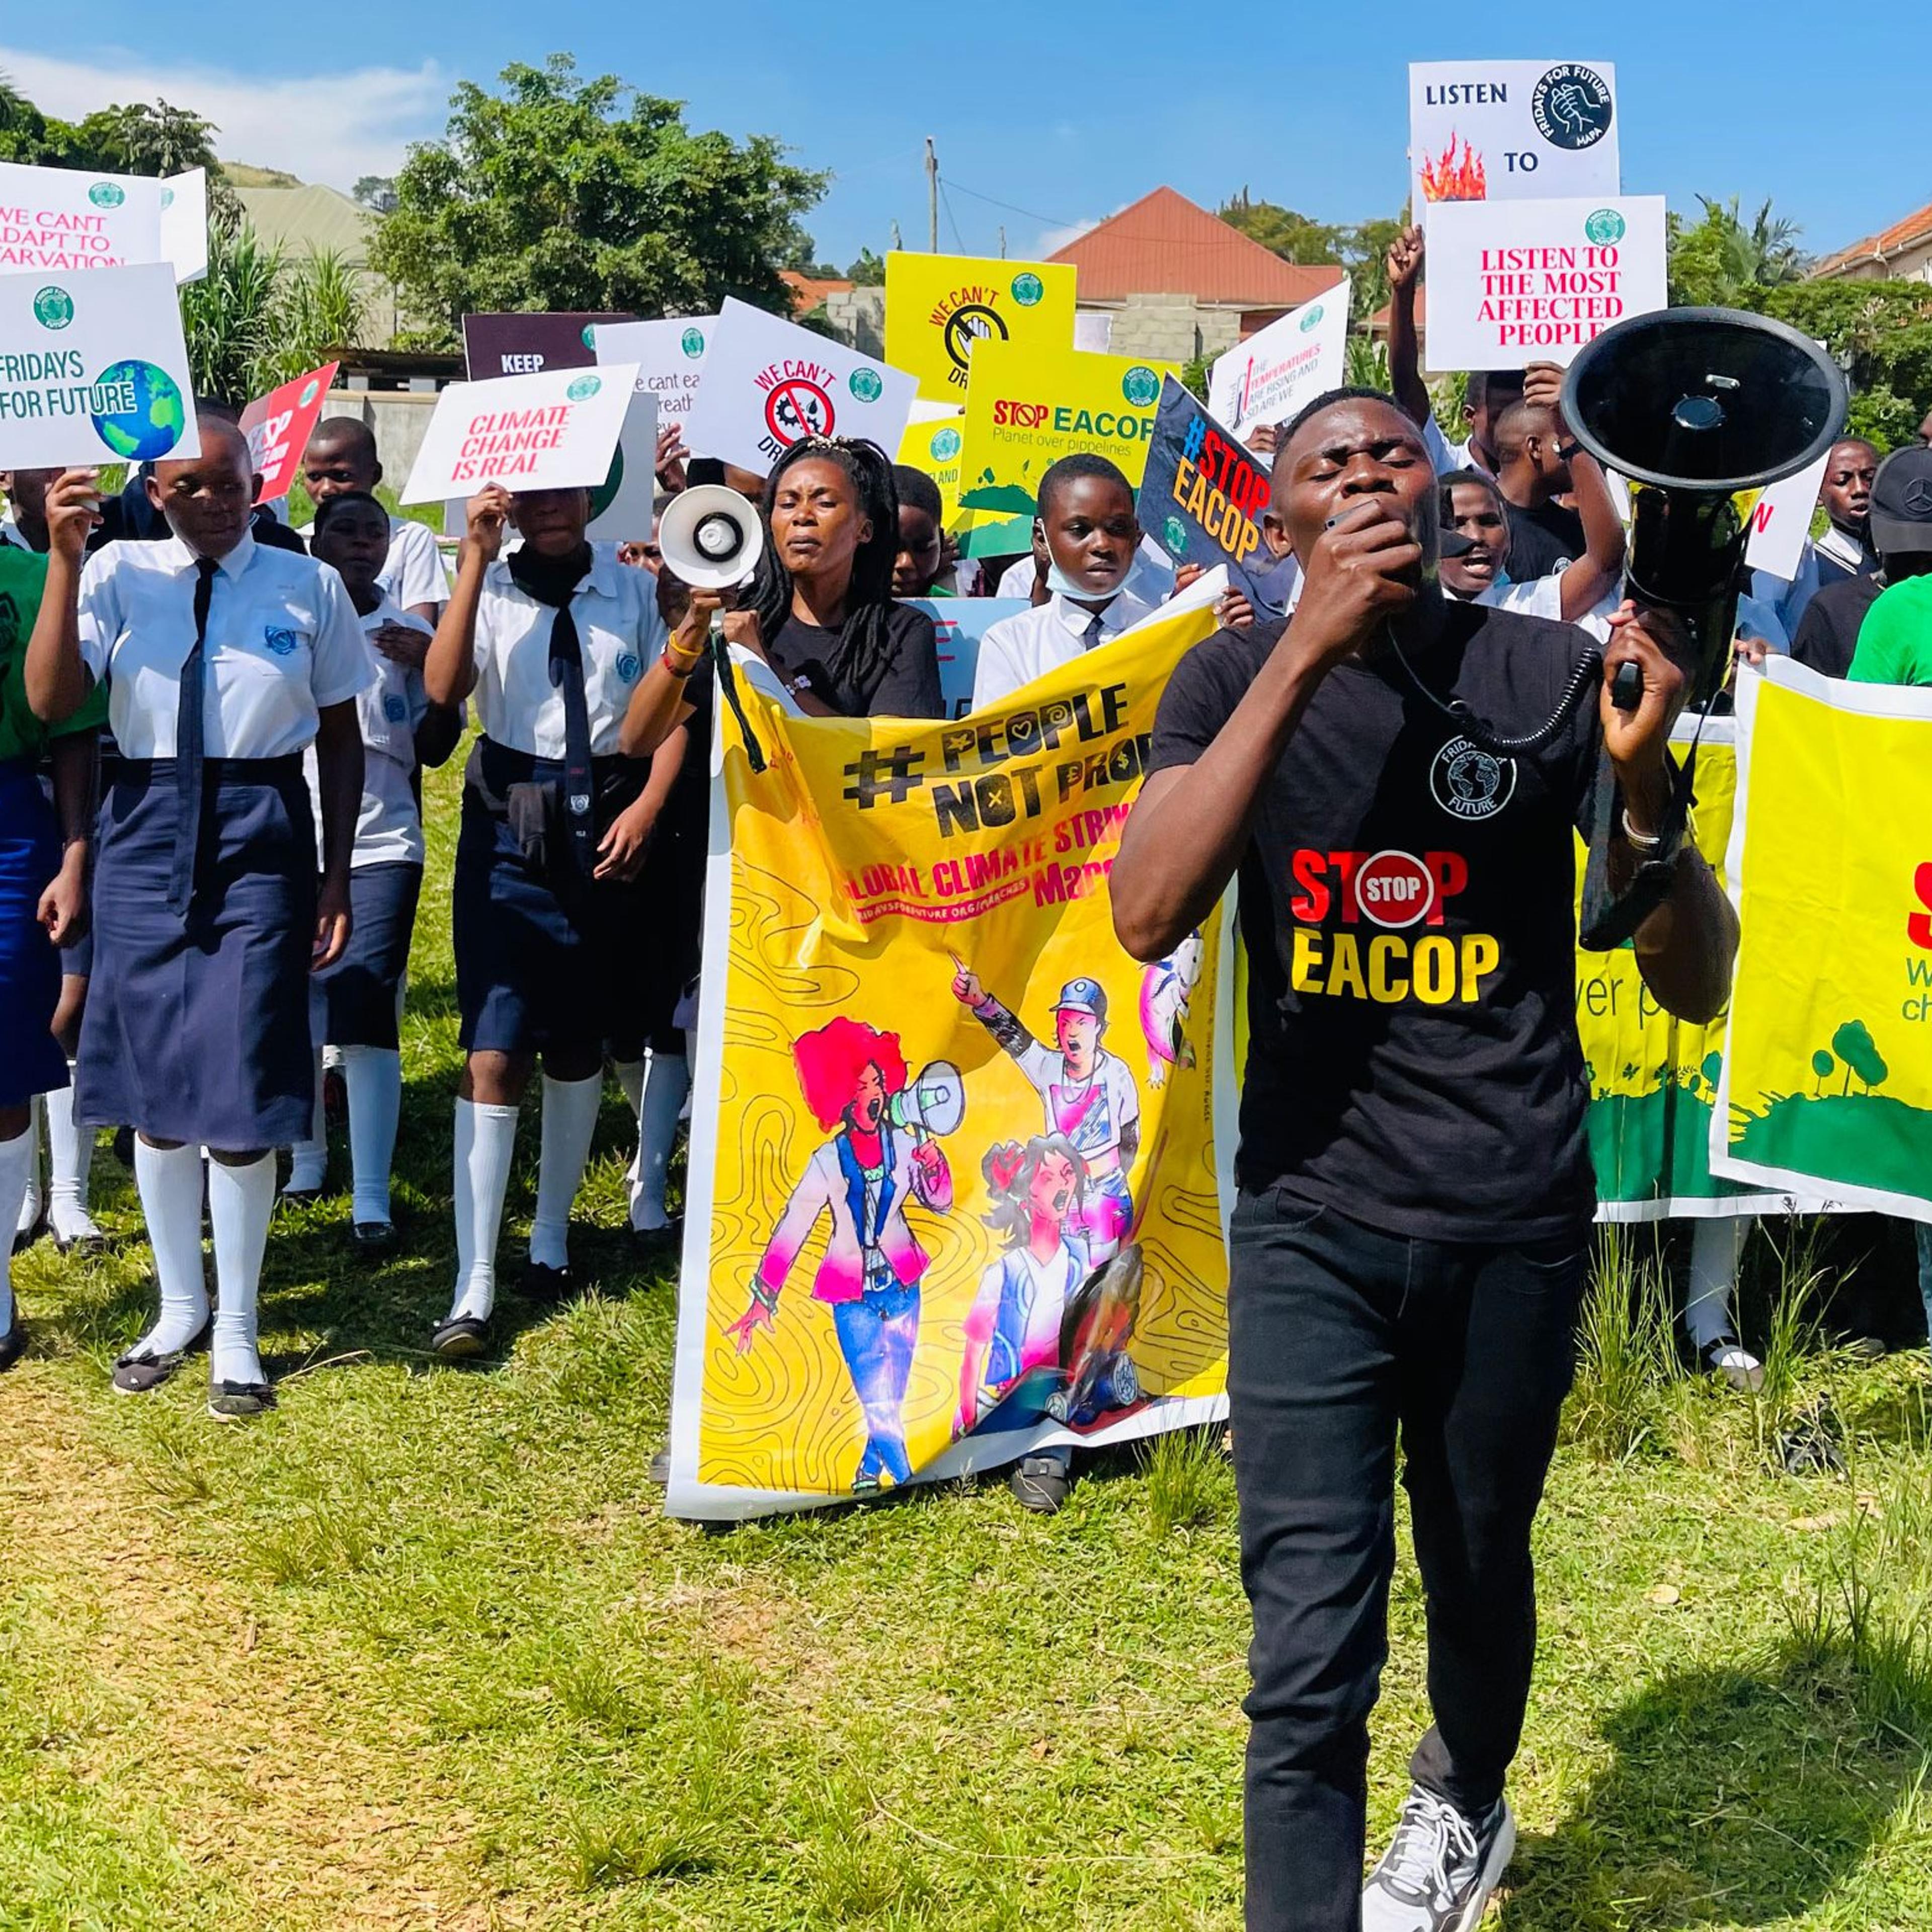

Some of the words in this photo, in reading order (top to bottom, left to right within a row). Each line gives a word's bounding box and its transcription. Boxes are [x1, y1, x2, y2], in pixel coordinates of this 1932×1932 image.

[1426, 83, 1507, 105] LISTEN
[1534, 83, 1554, 137] FRIDAYS
[1546, 66, 1570, 84] FOR
[1574, 66, 1609, 103] FUTURE
[1577, 127, 1602, 146] MAPA
[1504, 152, 1538, 173] TO
[0, 227, 70, 248] DAPT
[76, 235, 110, 252] TO
[1481, 247, 1577, 271] LISTEN
[1583, 247, 1619, 268] TO
[1481, 274, 1534, 296] THE
[1545, 271, 1621, 295] MOST
[929, 300, 953, 327] WE
[950, 286, 999, 307] CAN'T
[1477, 297, 1623, 321] AFFECTED
[501, 355, 544, 373] KEEP
[754, 364, 783, 391] WE
[783, 360, 836, 388] CAN'T
[1298, 358, 1318, 376] AND
[649, 373, 679, 390] cant
[948, 367, 969, 390] DR
[0, 390, 42, 419] FOR
[46, 383, 135, 416] FUTURE
[994, 400, 1049, 428] STOP
[469, 405, 575, 435] CLIMATE
[461, 428, 568, 458] CHANGE
[758, 436, 782, 462] DR
[993, 428, 1033, 445] Planet
[1037, 435, 1064, 447] over
[1068, 439, 1131, 456] pippelines
[451, 459, 477, 481] IS
[479, 453, 538, 477] REAL
[1182, 414, 1271, 520] #STOP
[1173, 455, 1259, 563] EACOP
[942, 683, 1128, 772] PEOPLE
[1441, 740, 1477, 763] FRIDA
[932, 765, 1042, 838] NOT
[1448, 796, 1497, 815] FUTURE
[847, 862, 928, 900] LOBAL
[932, 834, 1048, 897] CLIMATE
[1053, 803, 1130, 852] STRIK
[1366, 877, 1421, 902] STOP
[1292, 927, 1499, 1004] EACOP
